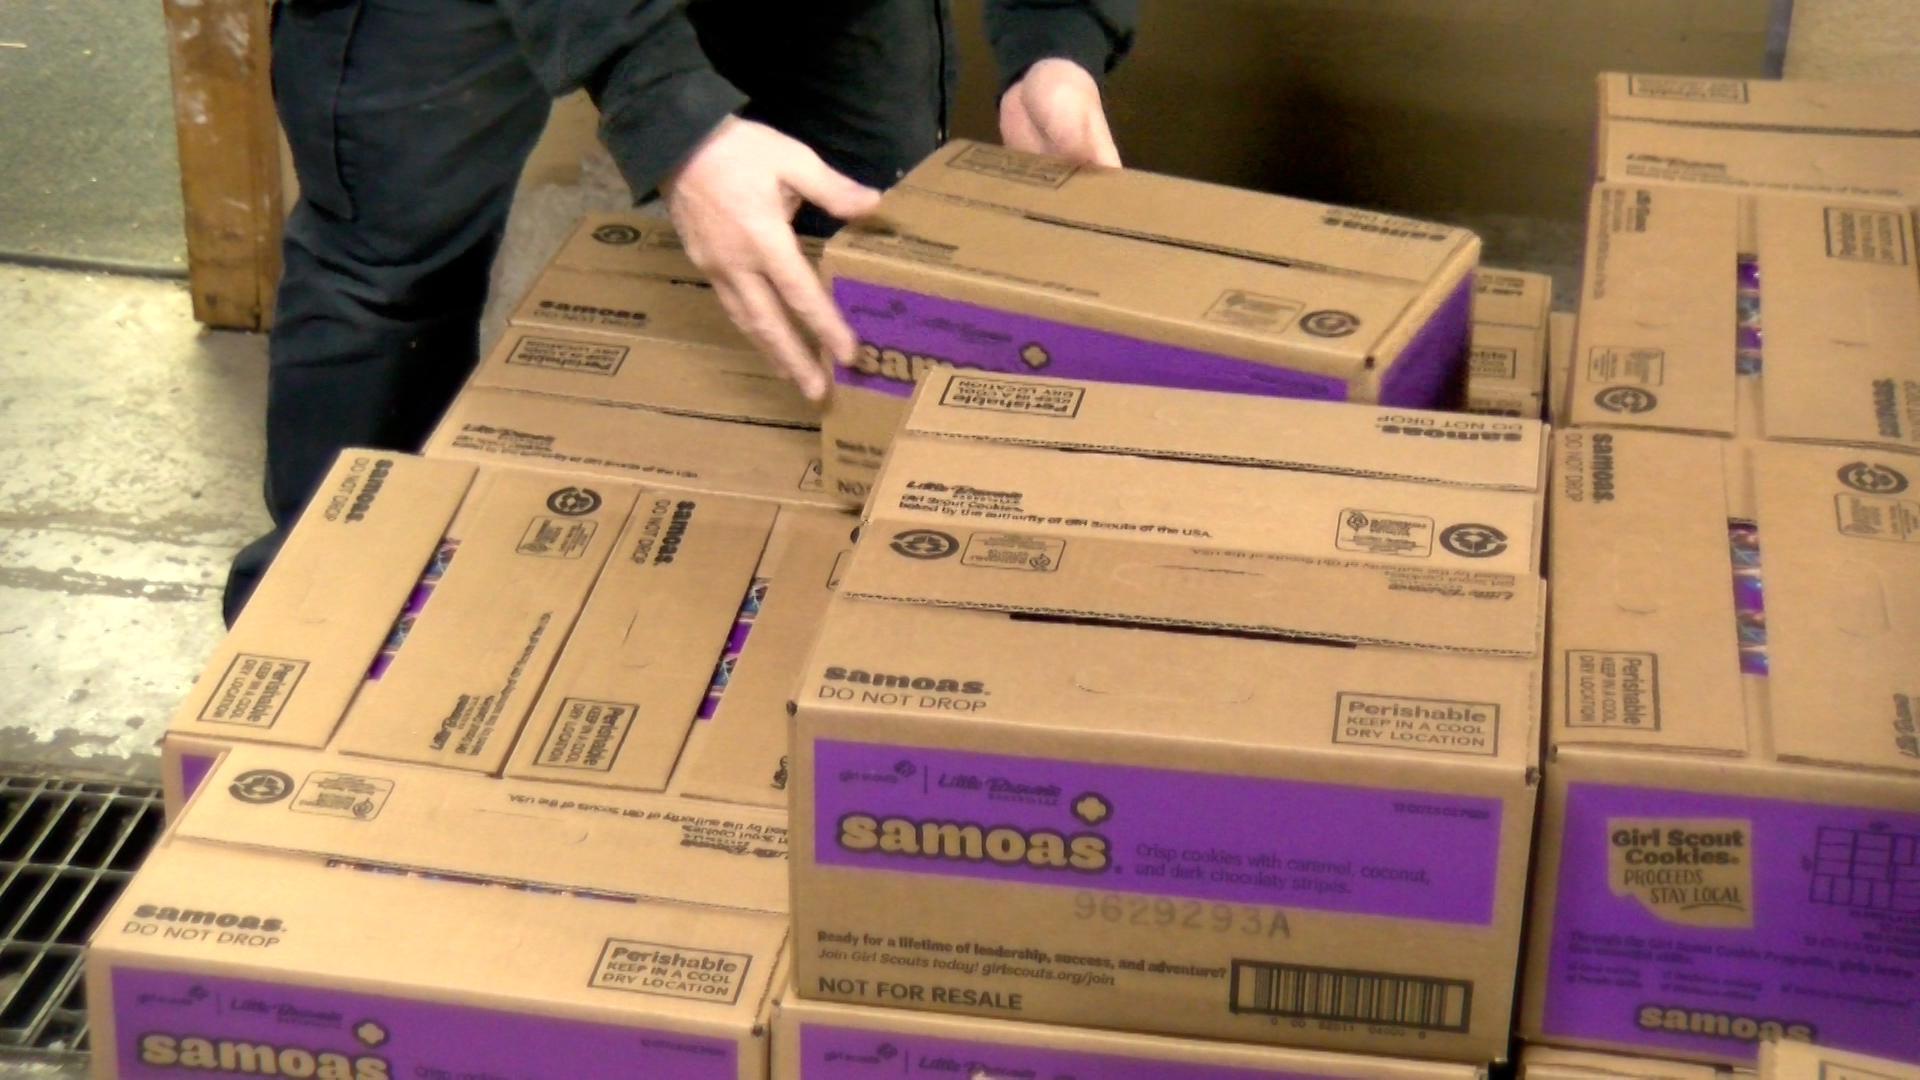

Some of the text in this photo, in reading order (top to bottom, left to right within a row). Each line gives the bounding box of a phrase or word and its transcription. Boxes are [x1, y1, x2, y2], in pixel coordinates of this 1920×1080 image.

[1376, 415, 1435, 426] DROP
[1442, 420, 1485, 430] NOT
[818, 684, 987, 713] DO NOT DROP
[1580, 677, 1596, 722] LOCATION
[1622, 656, 1647, 726] Perishable
[1346, 715, 1486, 735] KEEP IN A COOL
[1348, 701, 1487, 723] Perishable
[1345, 727, 1485, 747] DRY LOCATION
[1612, 828, 1743, 848] Girl Scout
[1135, 842, 1177, 863] Crisp
[1181, 848, 1241, 866] cookies
[1248, 853, 1281, 869] with
[1135, 862, 1166, 876] and
[1170, 864, 1204, 880] dark
[1210, 868, 1285, 891] chocolaty
[1624, 868, 1704, 887] PROCEEDS
[1650, 885, 1741, 904] STAY LOCAL
[121, 921, 280, 948] DO NOT DROP
[611, 946, 737, 973] Perishable
[817, 931, 1227, 979] Ready for a lifetime of leadership, success, and adventure?
[818, 949, 1115, 986] Join Girl Scouts today! girlscouts.org/join
[601, 971, 729, 996] DRY LOCATION
[606, 961, 732, 984] KEEP IN A COOL
[818, 976, 1022, 1011] NOT FOR RESALE
